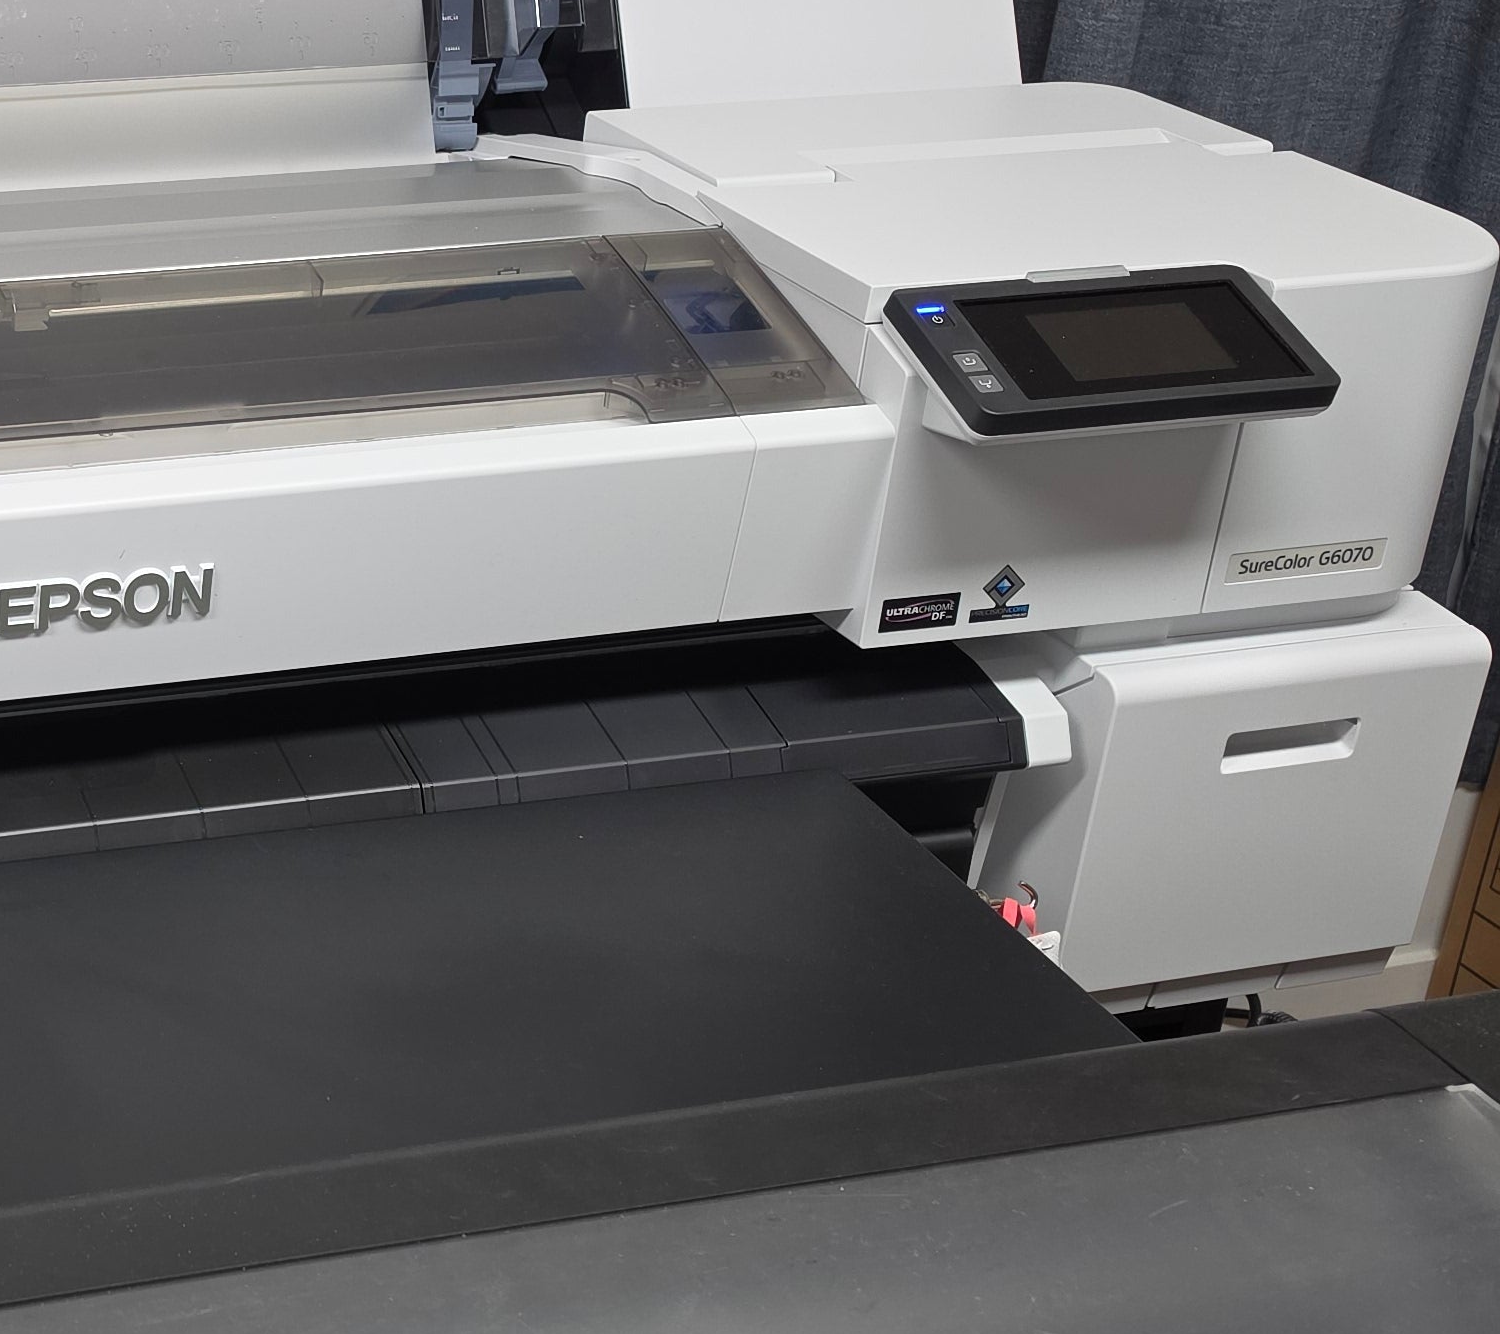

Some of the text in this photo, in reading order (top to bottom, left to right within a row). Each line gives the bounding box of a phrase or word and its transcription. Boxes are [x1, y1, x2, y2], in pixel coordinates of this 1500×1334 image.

[1238, 546, 1374, 575] SureColor G6070
[886, 602, 955, 617] ULTRACHROME
[931, 611, 947, 621] DF
[971, 605, 1029, 617] PRECISIONCORE
